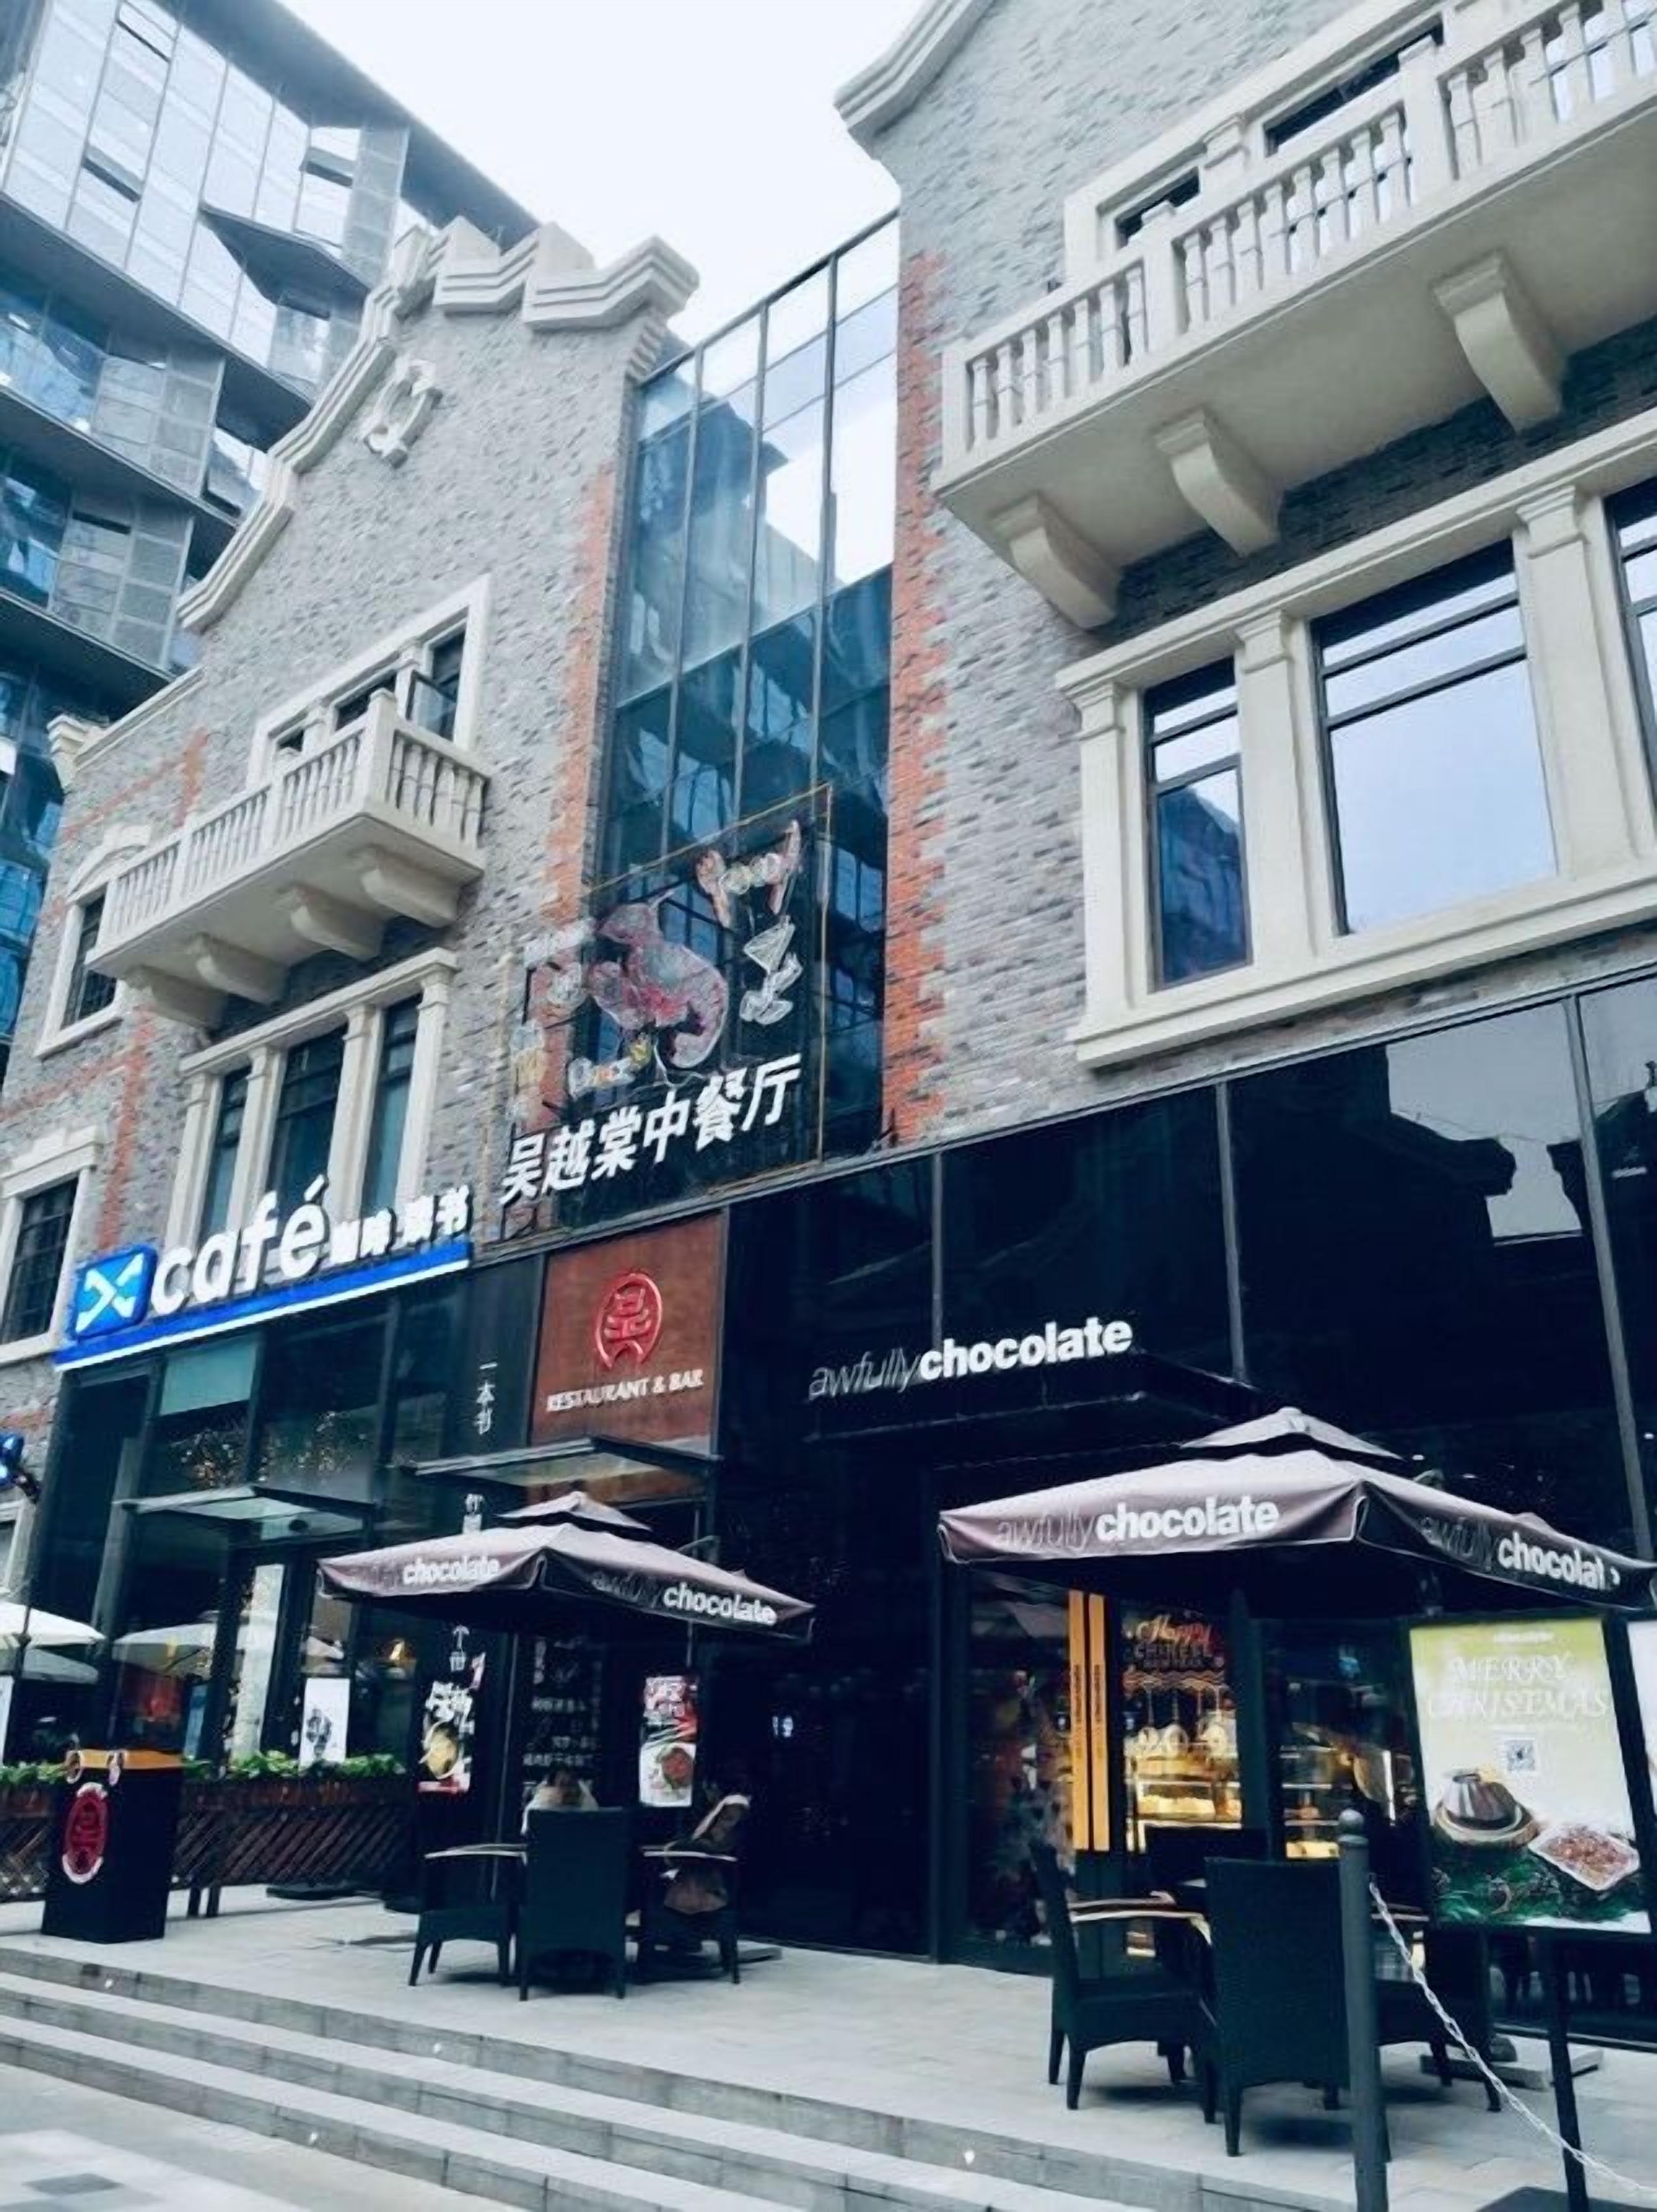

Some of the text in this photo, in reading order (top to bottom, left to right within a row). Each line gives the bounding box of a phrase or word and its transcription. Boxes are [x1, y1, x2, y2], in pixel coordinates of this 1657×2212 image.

[150, 1174, 325, 1315] café
[652, 1376, 664, 1393] &
[668, 1369, 703, 1391] BAR
[402, 1555, 501, 1586] chocolate
[663, 1581, 777, 1626] chocolate
